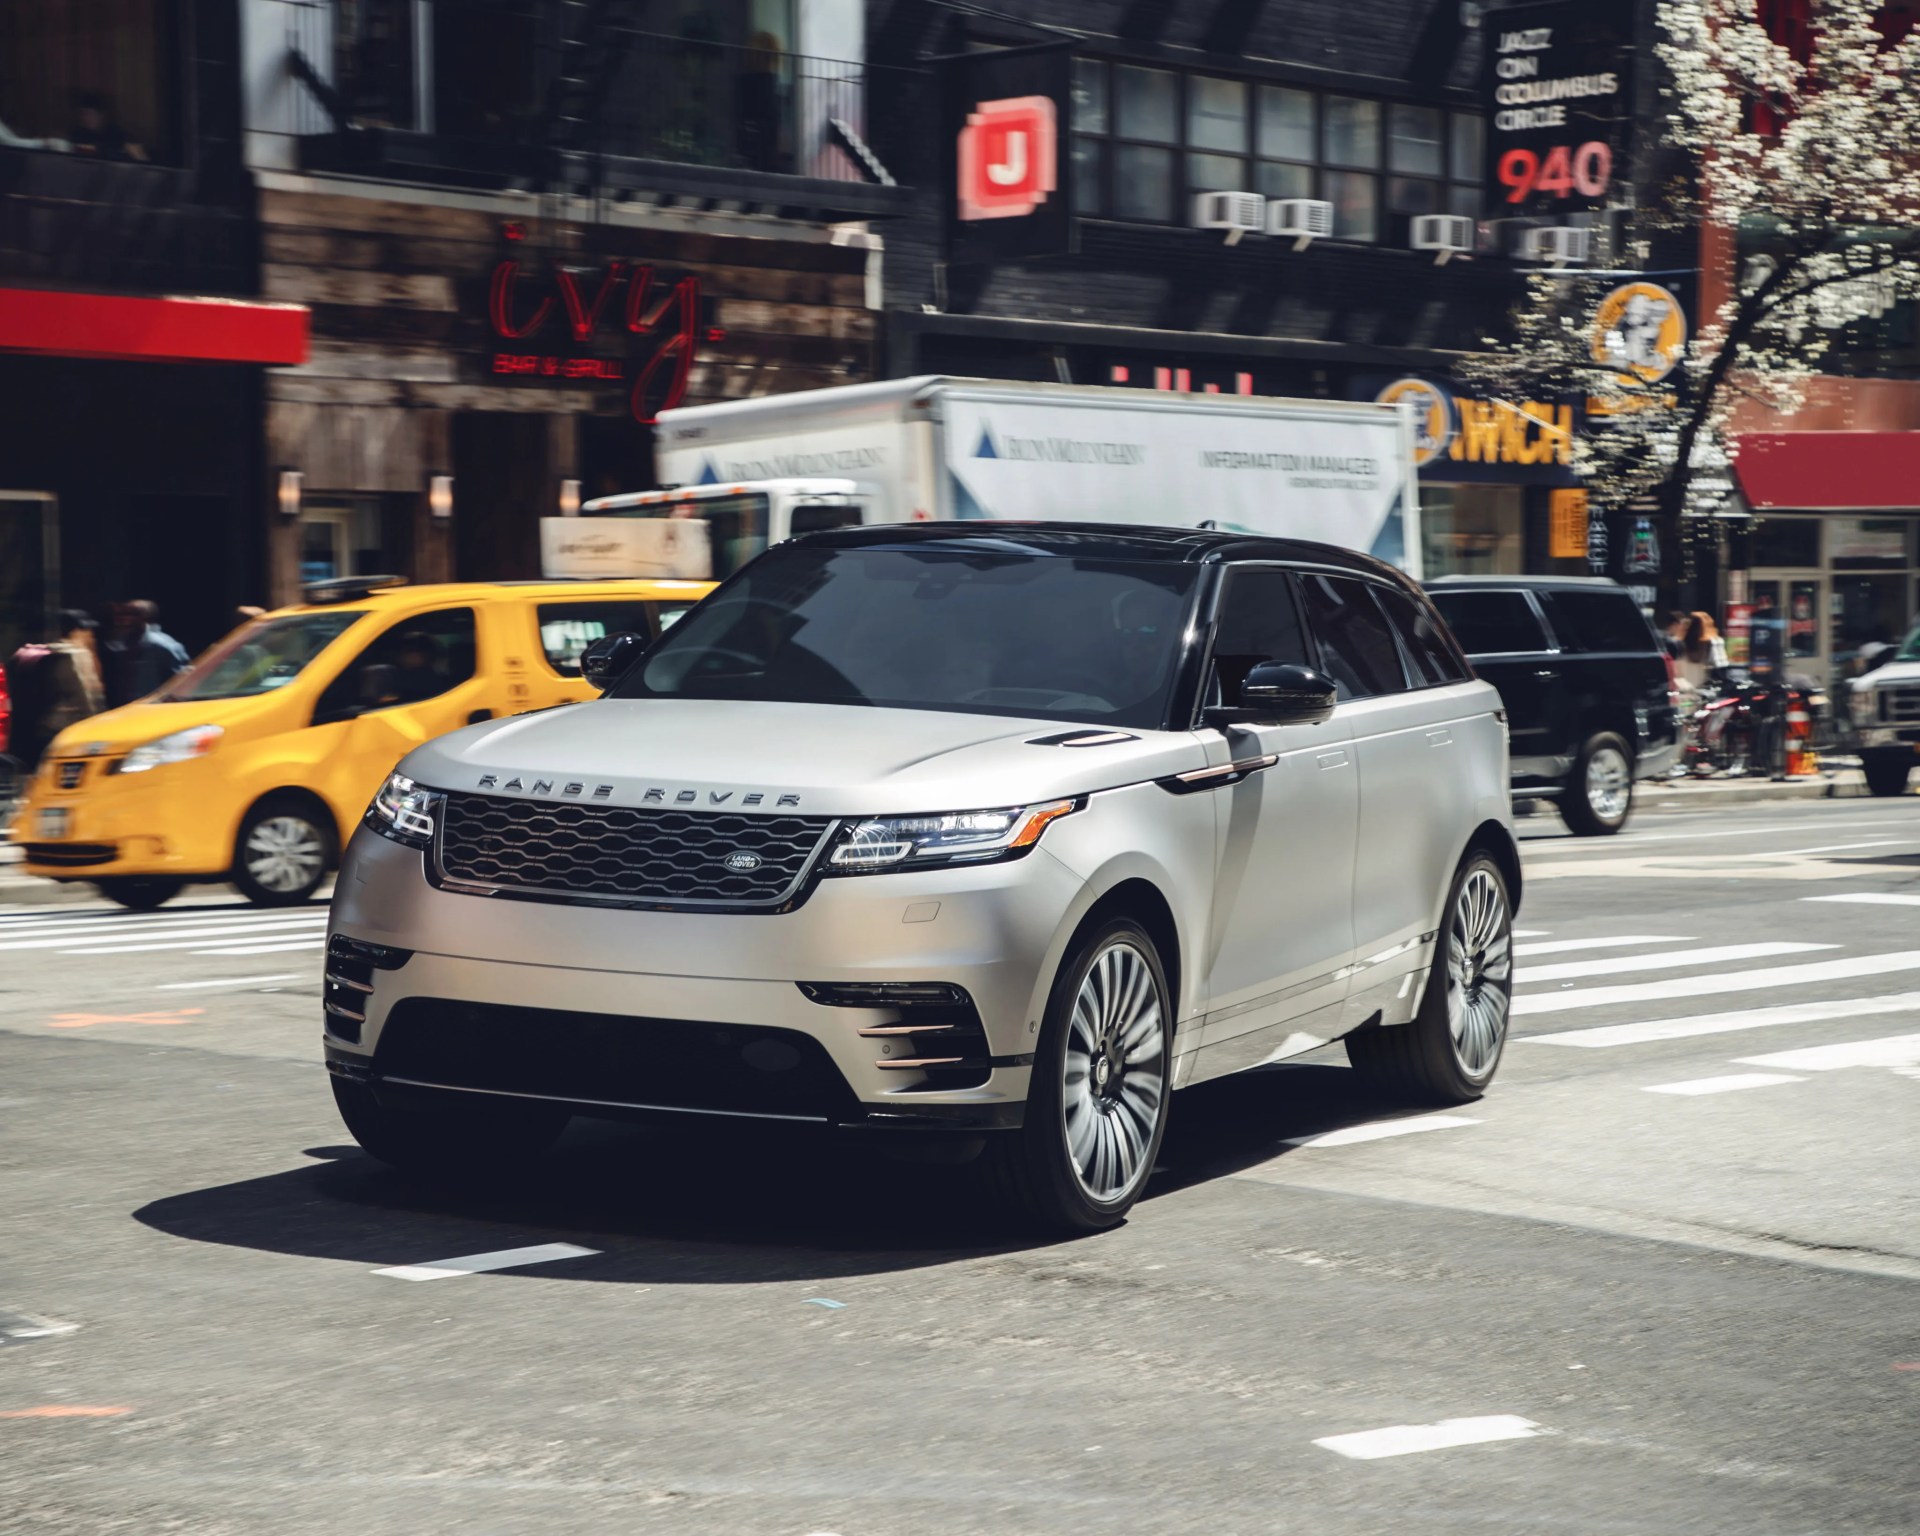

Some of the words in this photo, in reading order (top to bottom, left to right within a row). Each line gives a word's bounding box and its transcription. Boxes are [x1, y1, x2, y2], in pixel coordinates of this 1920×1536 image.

[1497, 28, 1552, 53] JAZZ
[1496, 56, 1538, 79] ON
[1495, 72, 1618, 105] COLUMBUS
[1495, 105, 1567, 131] CIRCLE
[986, 130, 1028, 186] J
[1497, 141, 1613, 204] 940
[478, 773, 615, 798] RANGE
[643, 787, 801, 807] ROVER
[732, 860, 756, 868] ROVER
